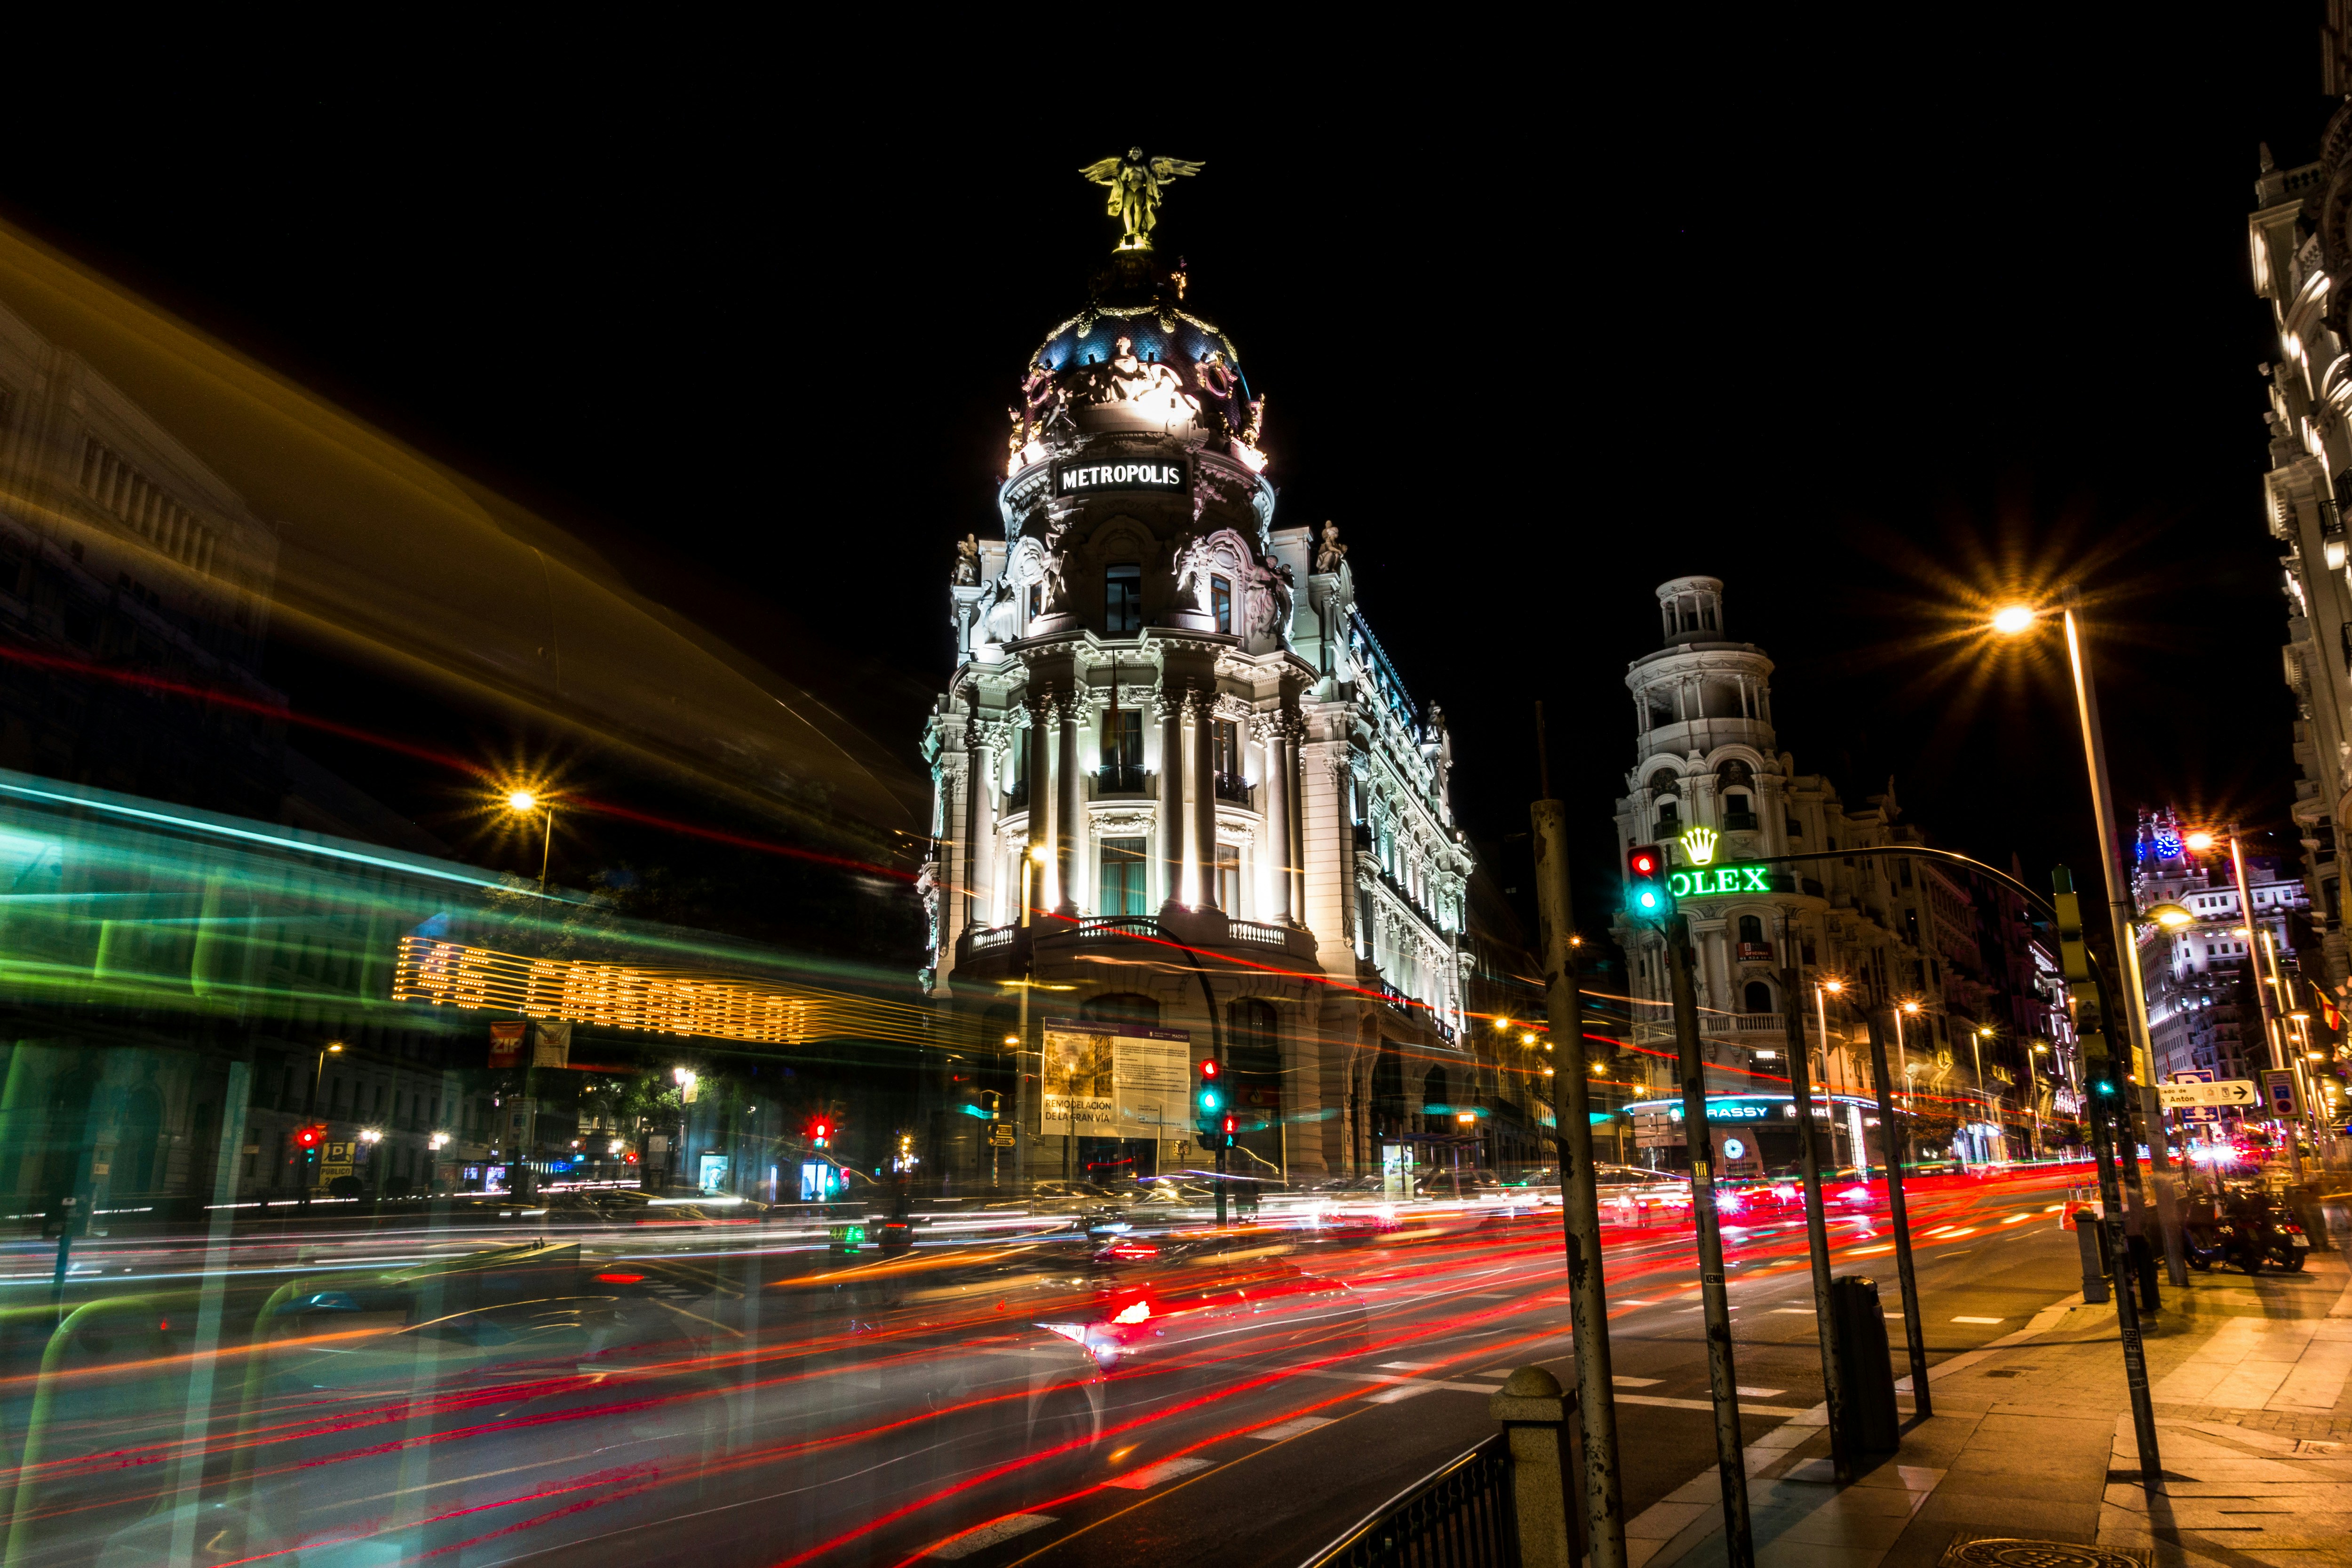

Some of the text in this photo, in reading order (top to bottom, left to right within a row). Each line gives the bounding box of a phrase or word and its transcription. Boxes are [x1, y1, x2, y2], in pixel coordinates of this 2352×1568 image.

[1063, 464, 1180, 490] METROPOLIS
[1668, 867, 1770, 897] OLEX
[491, 1038, 523, 1054] ZIP
[1046, 1099, 1111, 1110] REMODELACIÓN
[1707, 1107, 1768, 1118] RASSY
[1058, 1113, 1069, 1121] LA
[1070, 1113, 1094, 1122] GRAN
[1095, 1113, 1110, 1123] VÍA
[2124, 1329, 2139, 1352] BNE
